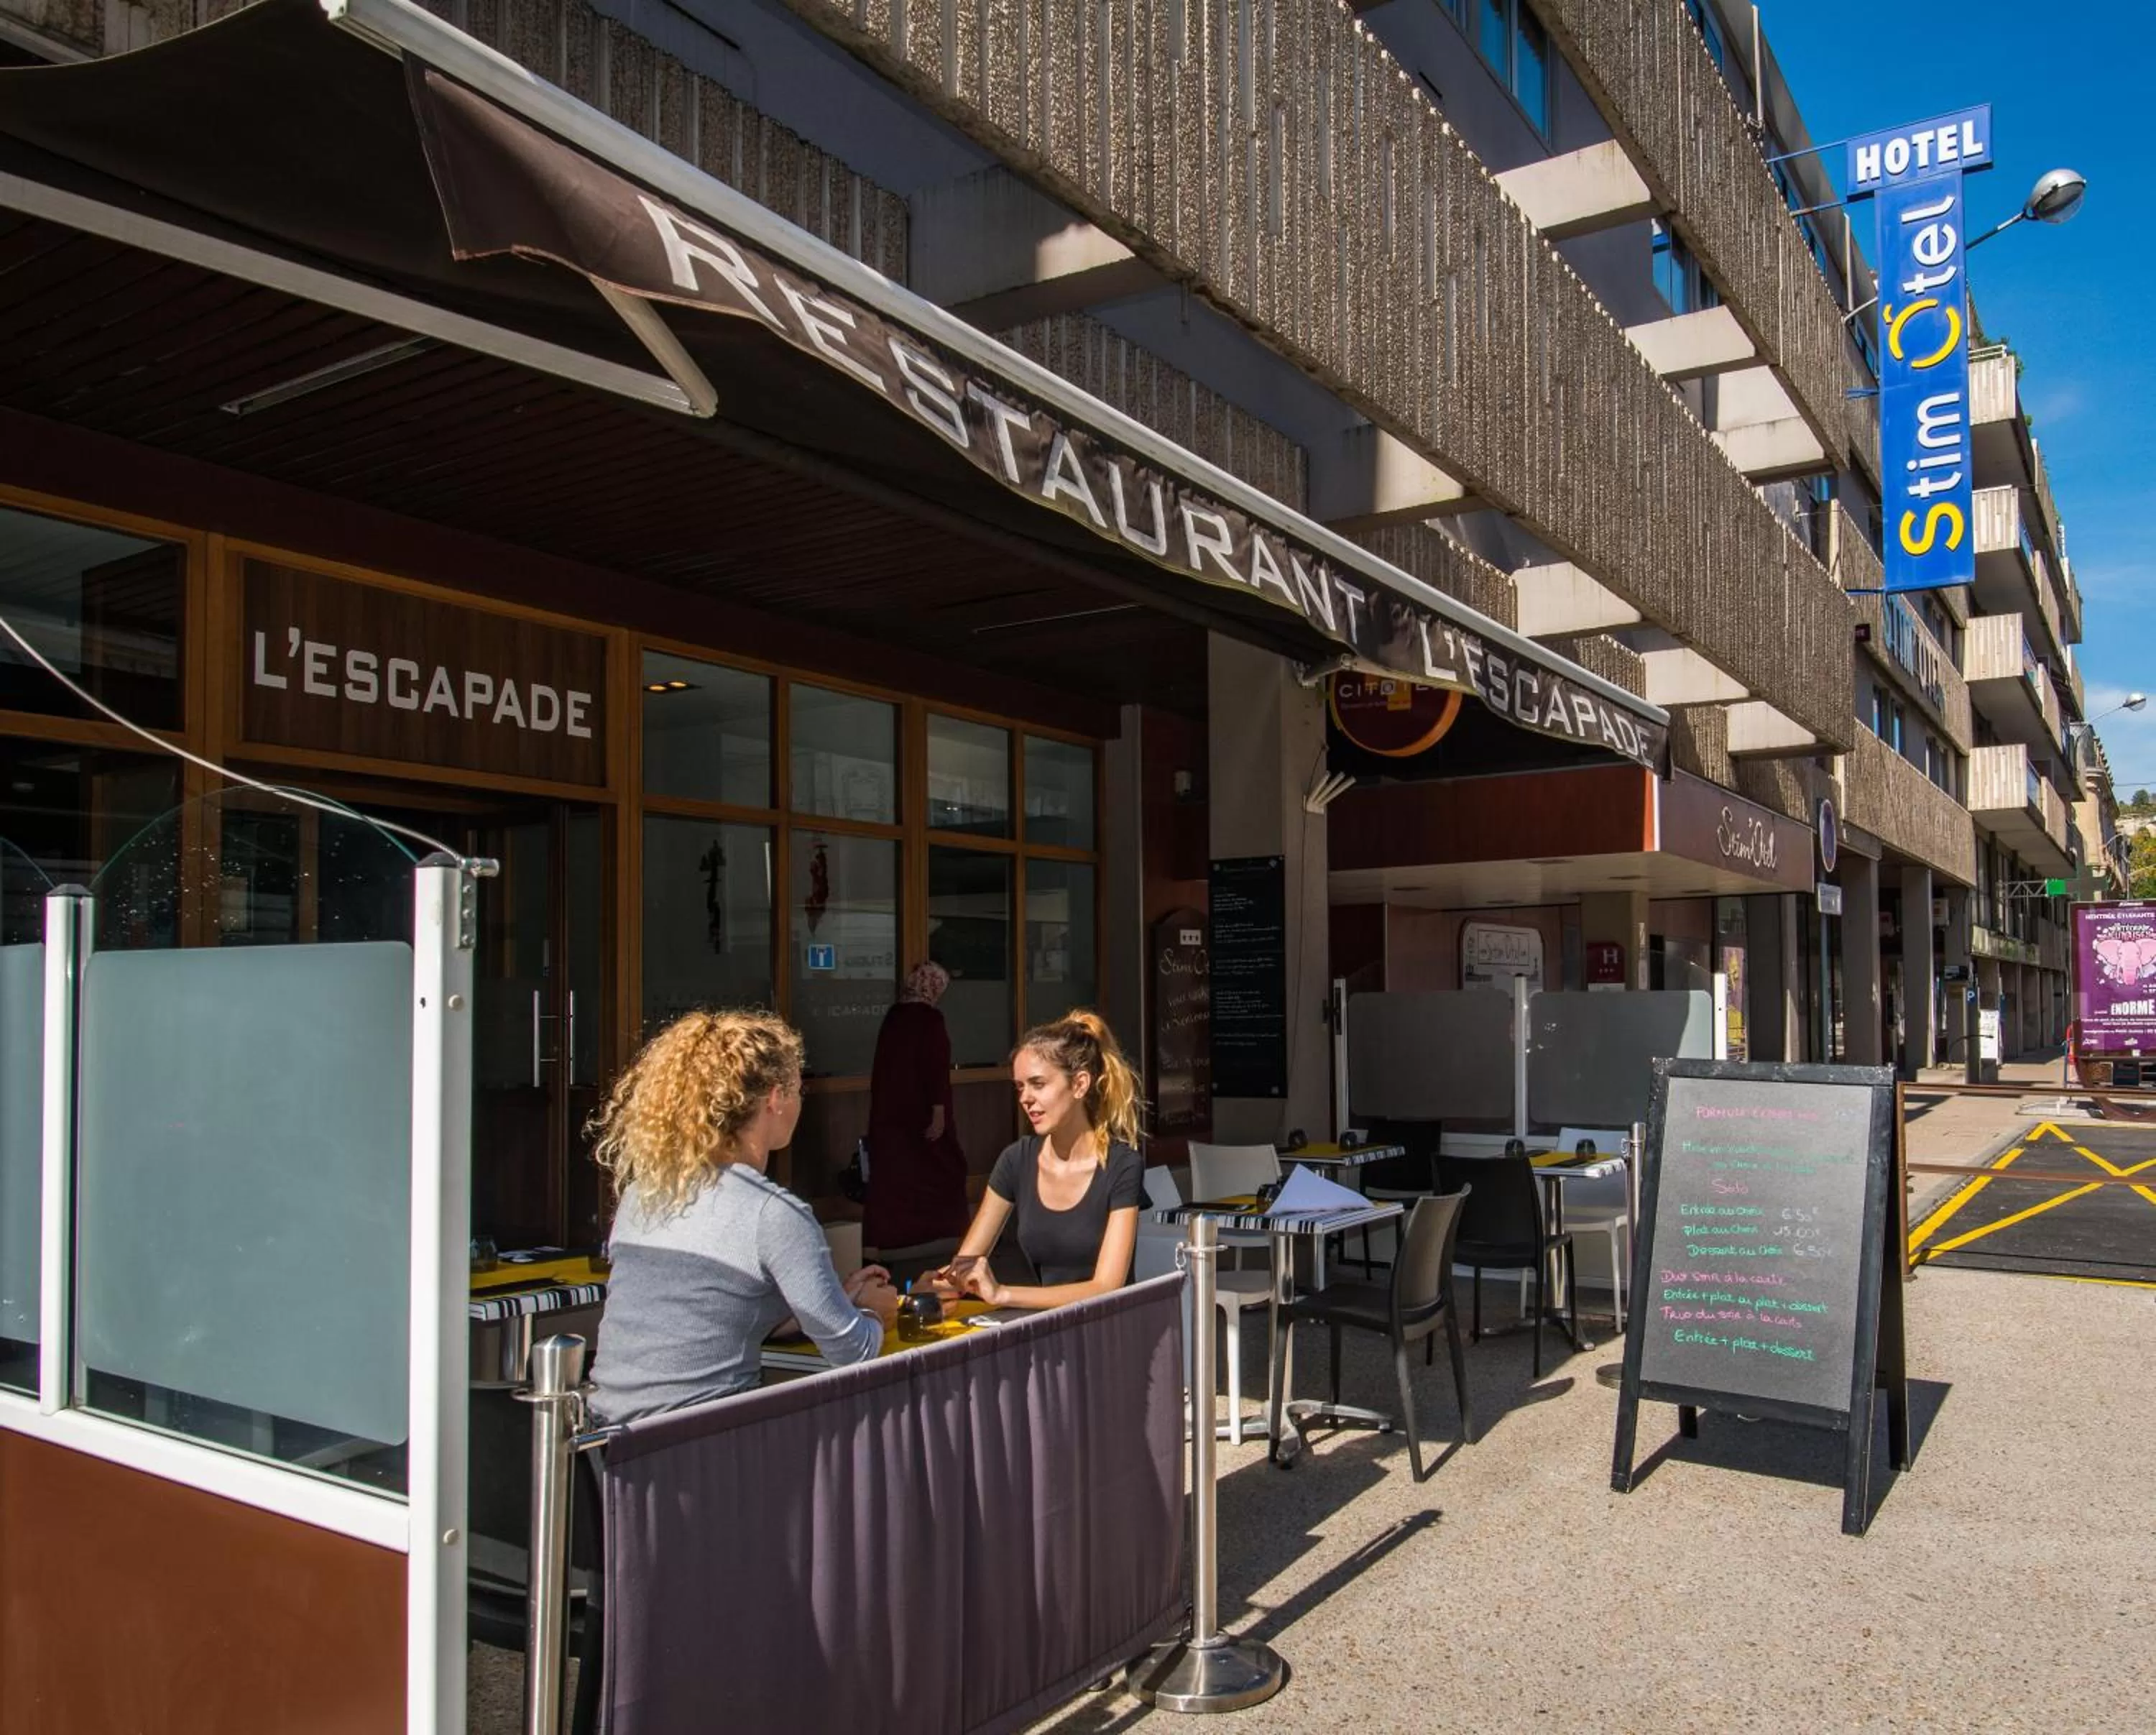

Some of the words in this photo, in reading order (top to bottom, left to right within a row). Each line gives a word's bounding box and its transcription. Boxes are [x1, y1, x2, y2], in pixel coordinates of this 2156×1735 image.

[1856, 120, 1984, 183] HOTEL
[637, 195, 1364, 643] RESTAURANT
[1422, 620, 1655, 767] L'ESCAPADE
[254, 627, 592, 739] L'ESCAPADE
[1603, 948, 1618, 965] H
[1967, 990, 1976, 1001] P
